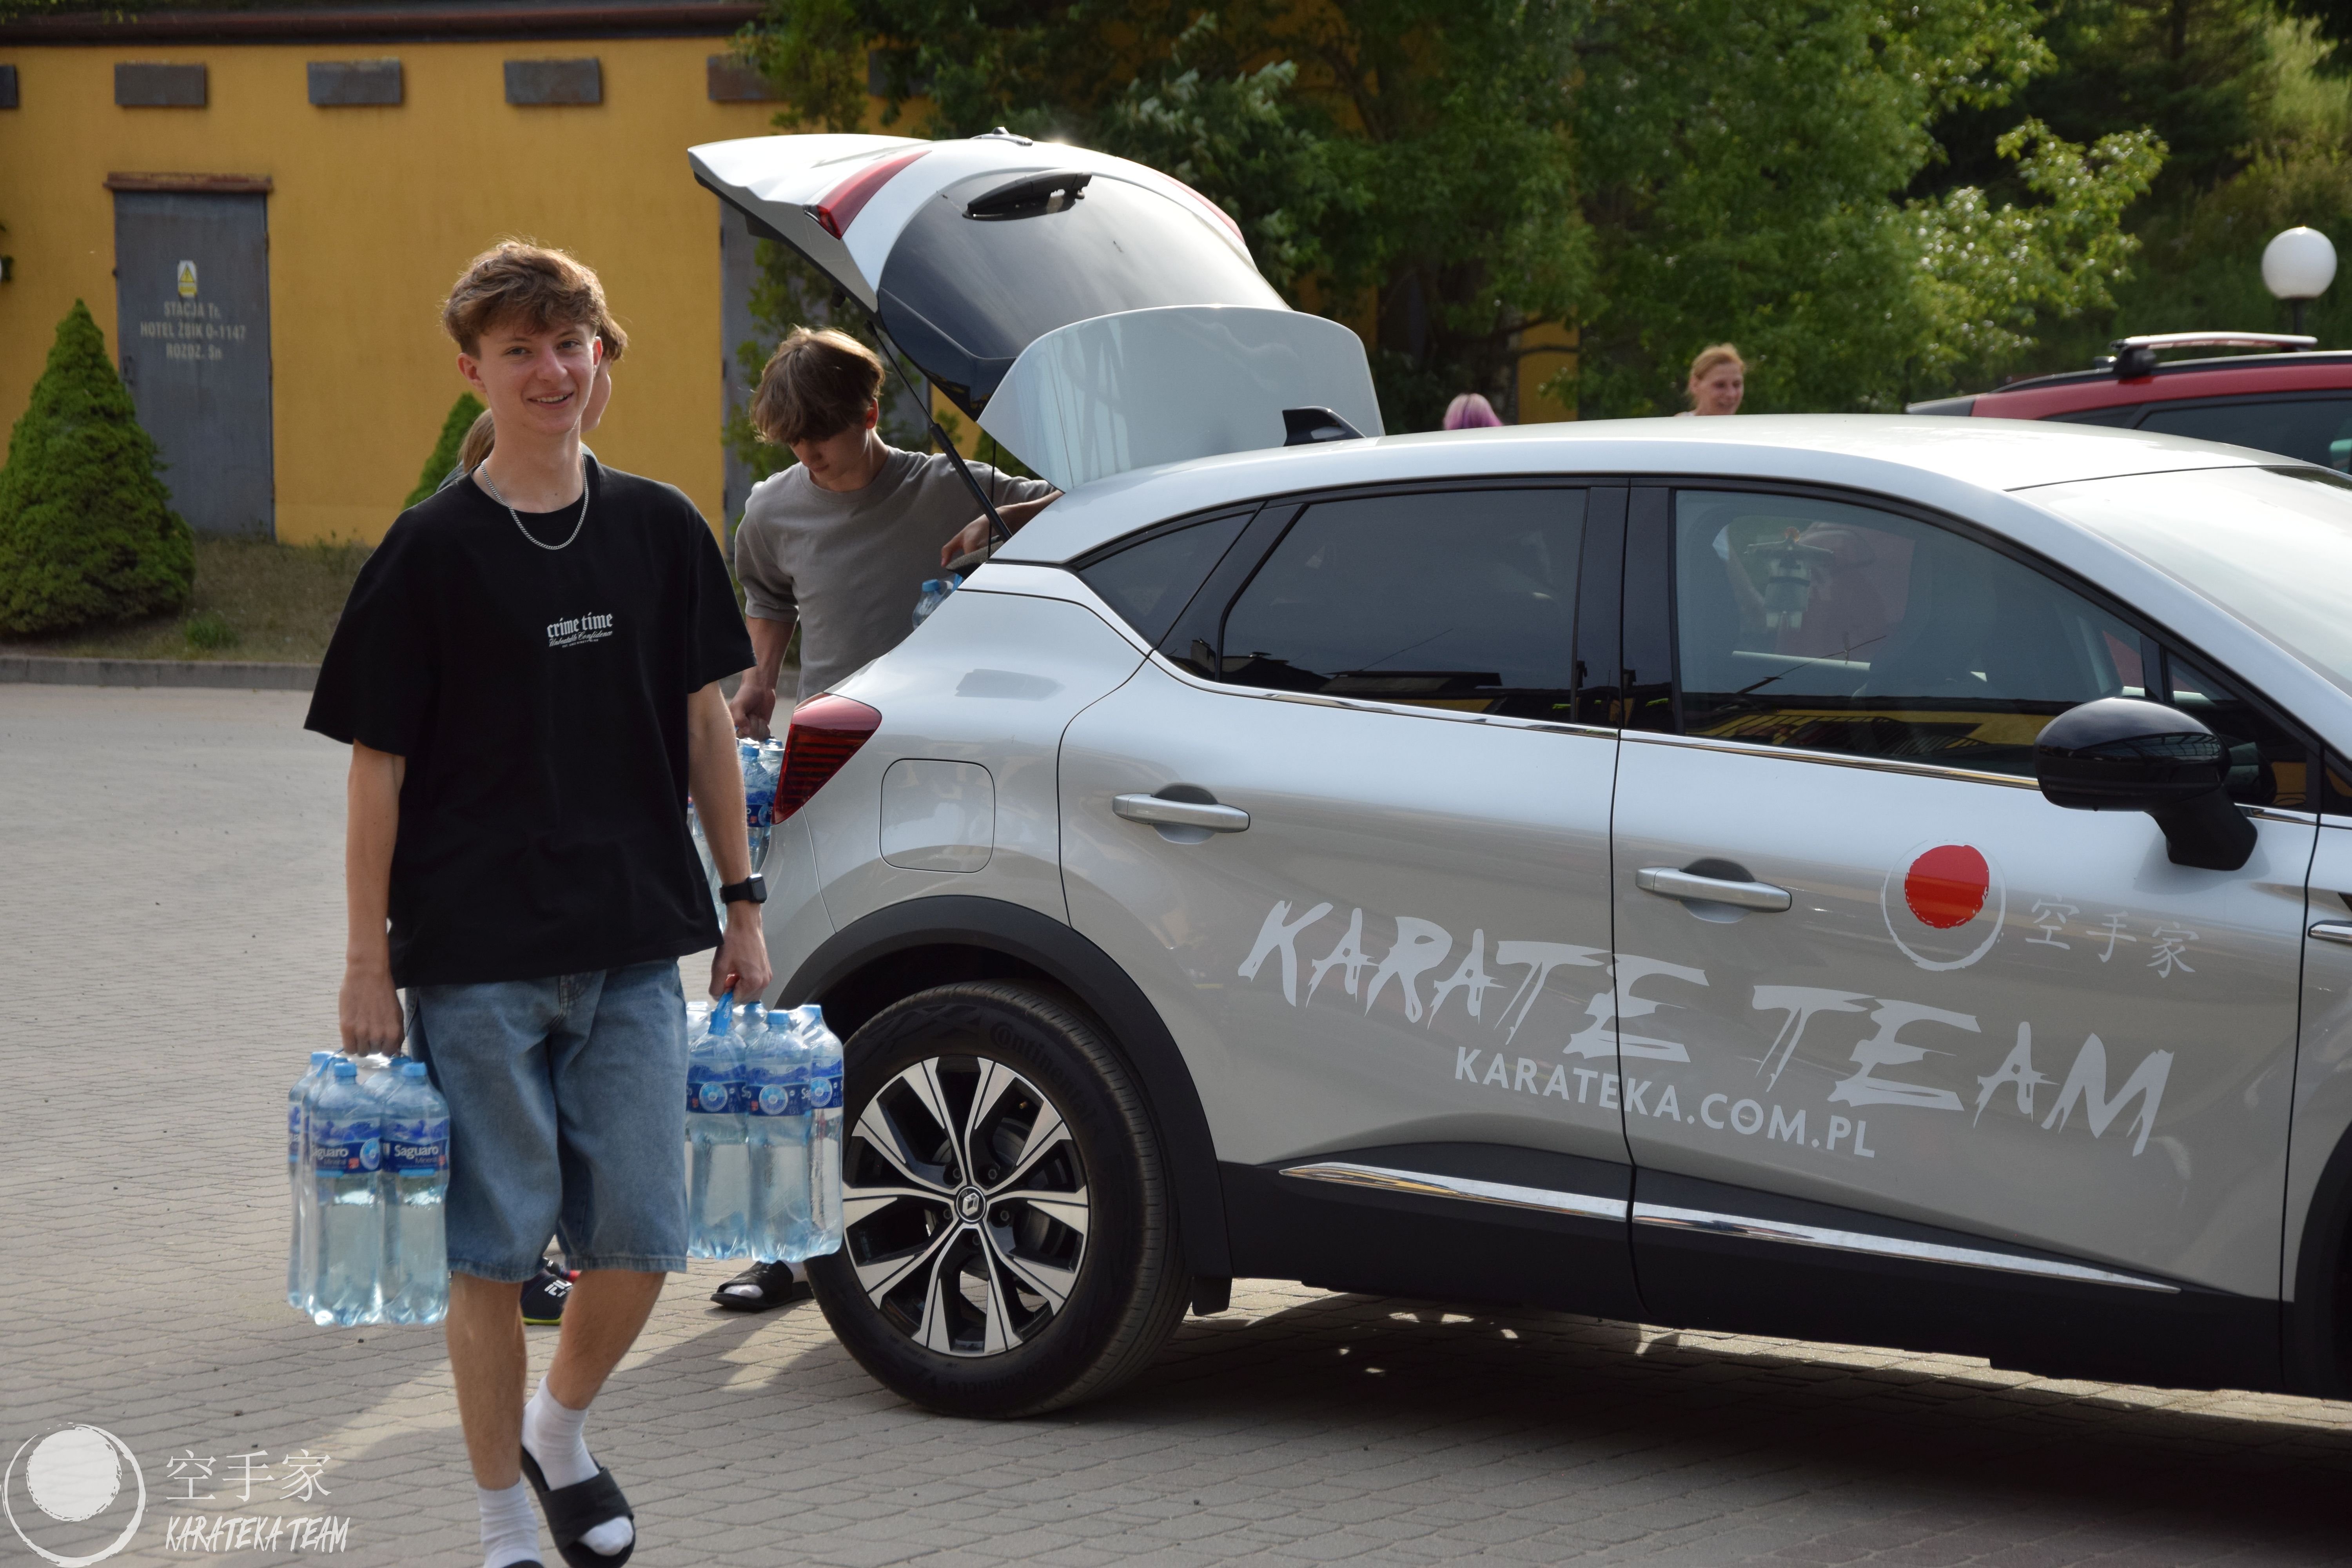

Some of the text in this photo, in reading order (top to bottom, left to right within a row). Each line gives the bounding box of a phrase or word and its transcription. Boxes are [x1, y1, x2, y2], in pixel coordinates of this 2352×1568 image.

[164, 301, 204, 318] STACJA
[140, 321, 175, 339] HOTEL
[547, 612, 613, 638] crime time
[577, 630, 613, 641] Confidence
[2025, 894, 2200, 978] 空手家
[1238, 900, 2175, 1157] KARATE TEAM
[989, 1020, 1098, 1123] Continental
[1455, 1046, 1875, 1158] KARATEKA.COM.PL
[394, 1144, 439, 1160] Saguaro
